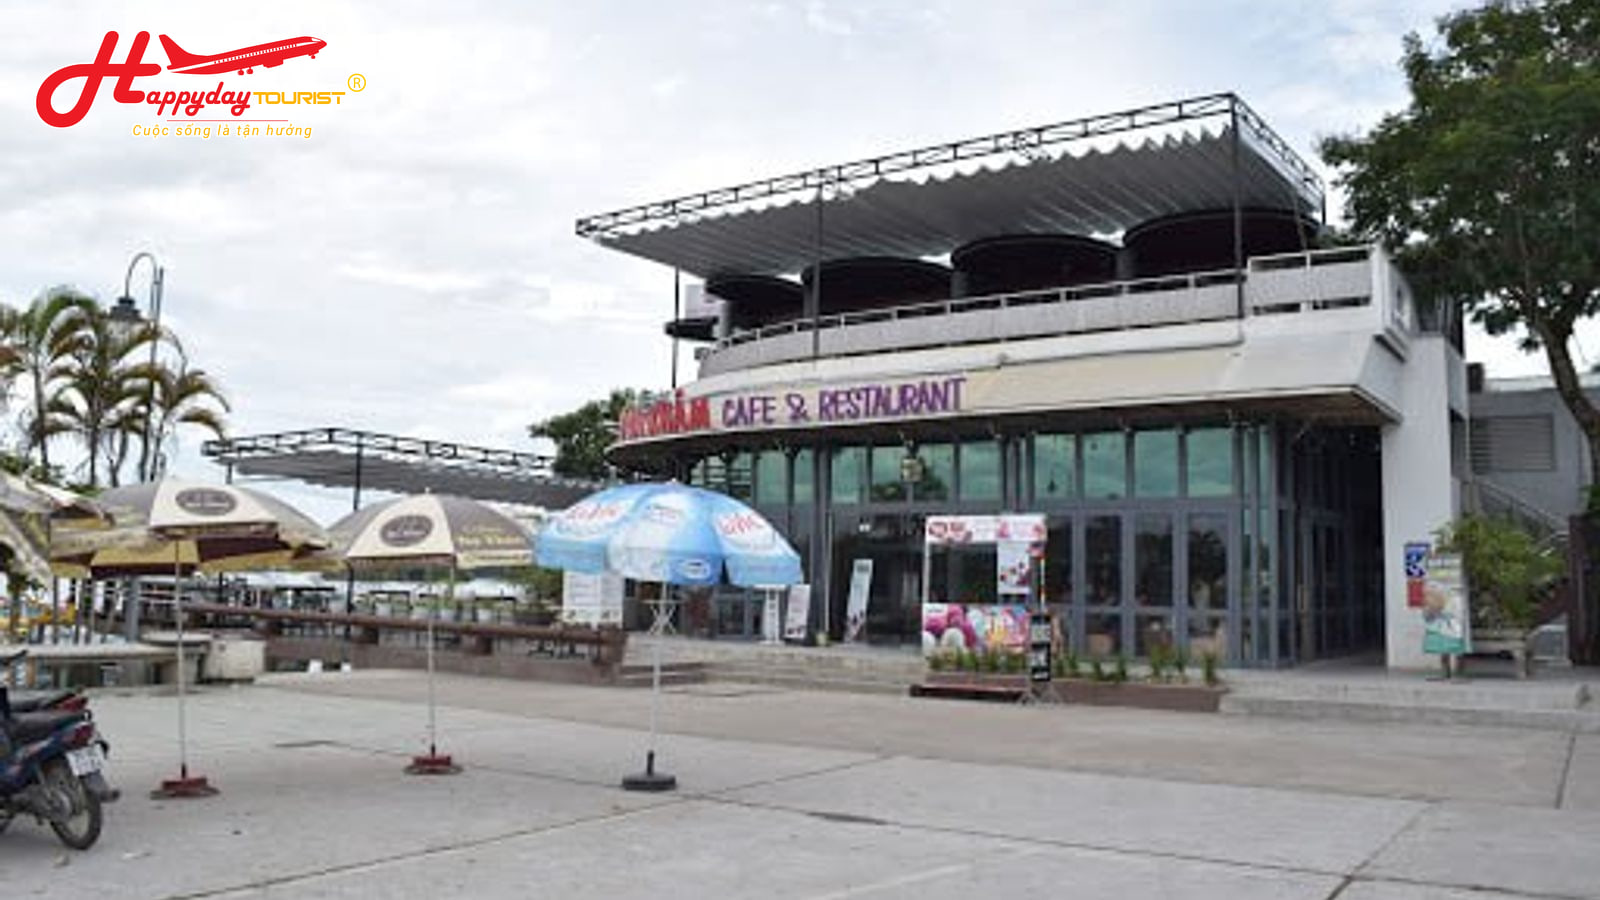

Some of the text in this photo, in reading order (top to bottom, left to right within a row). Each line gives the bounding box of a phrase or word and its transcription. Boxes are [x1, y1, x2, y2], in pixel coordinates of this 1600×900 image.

[721, 396, 777, 428] CAFE
[785, 393, 810, 422] &
[818, 378, 967, 422] RESTAURANT
